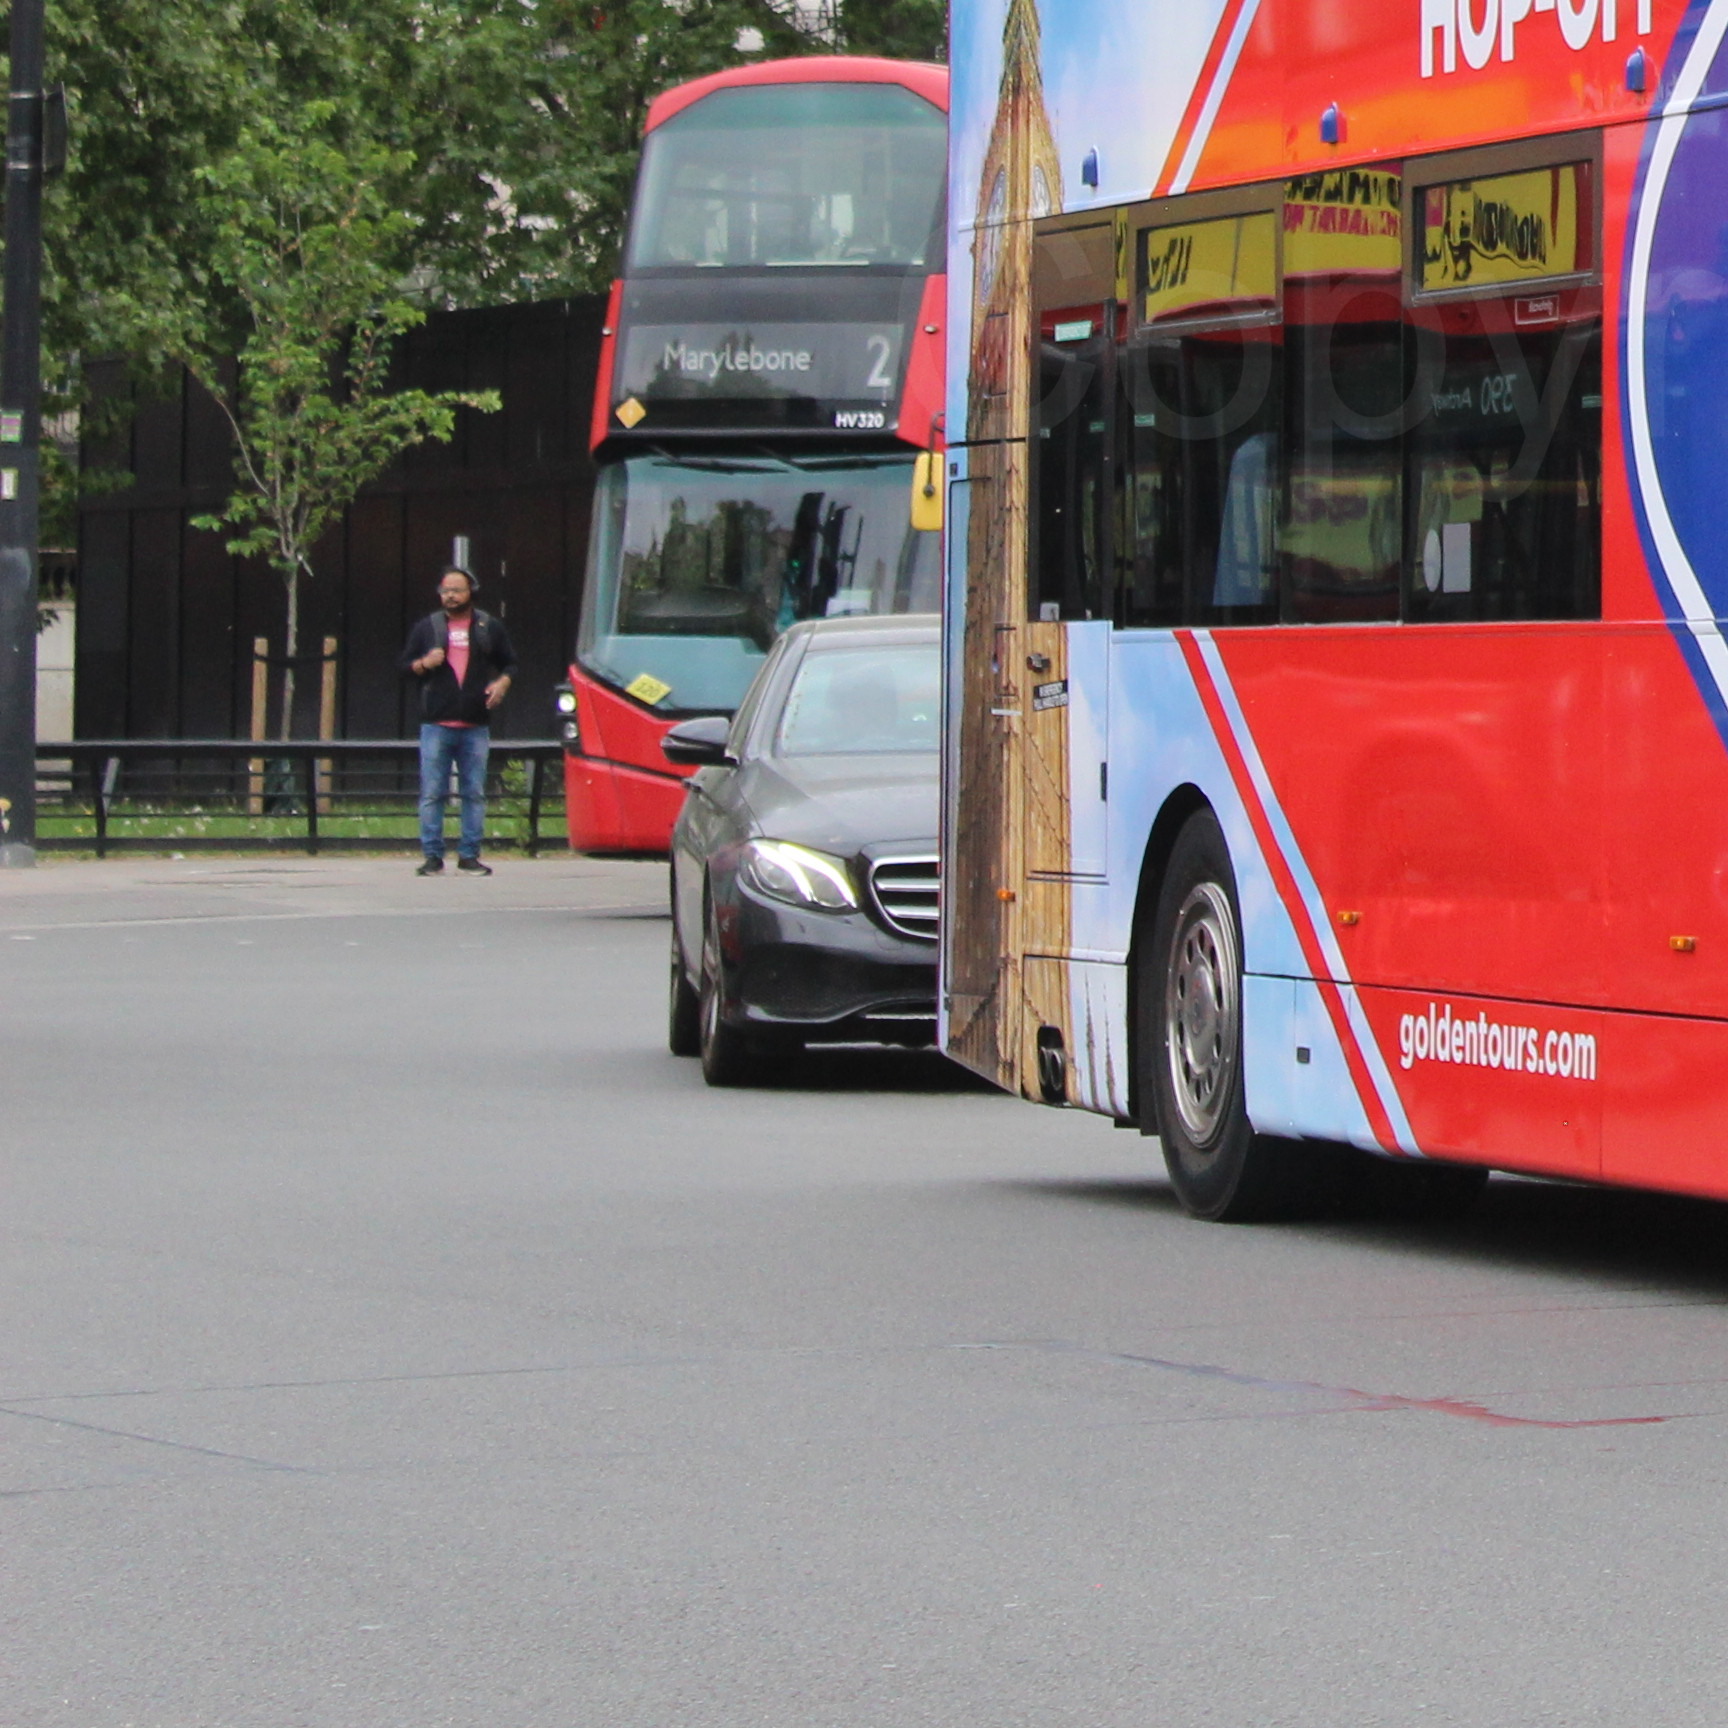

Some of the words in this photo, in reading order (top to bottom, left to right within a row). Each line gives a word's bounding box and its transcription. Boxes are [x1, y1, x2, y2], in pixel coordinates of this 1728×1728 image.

[663, 343, 813, 378] Marylebone
[866, 334, 891, 388] 2
[835, 411, 884, 429] HV320
[1399, 1003, 1597, 1083] goldentours.com
